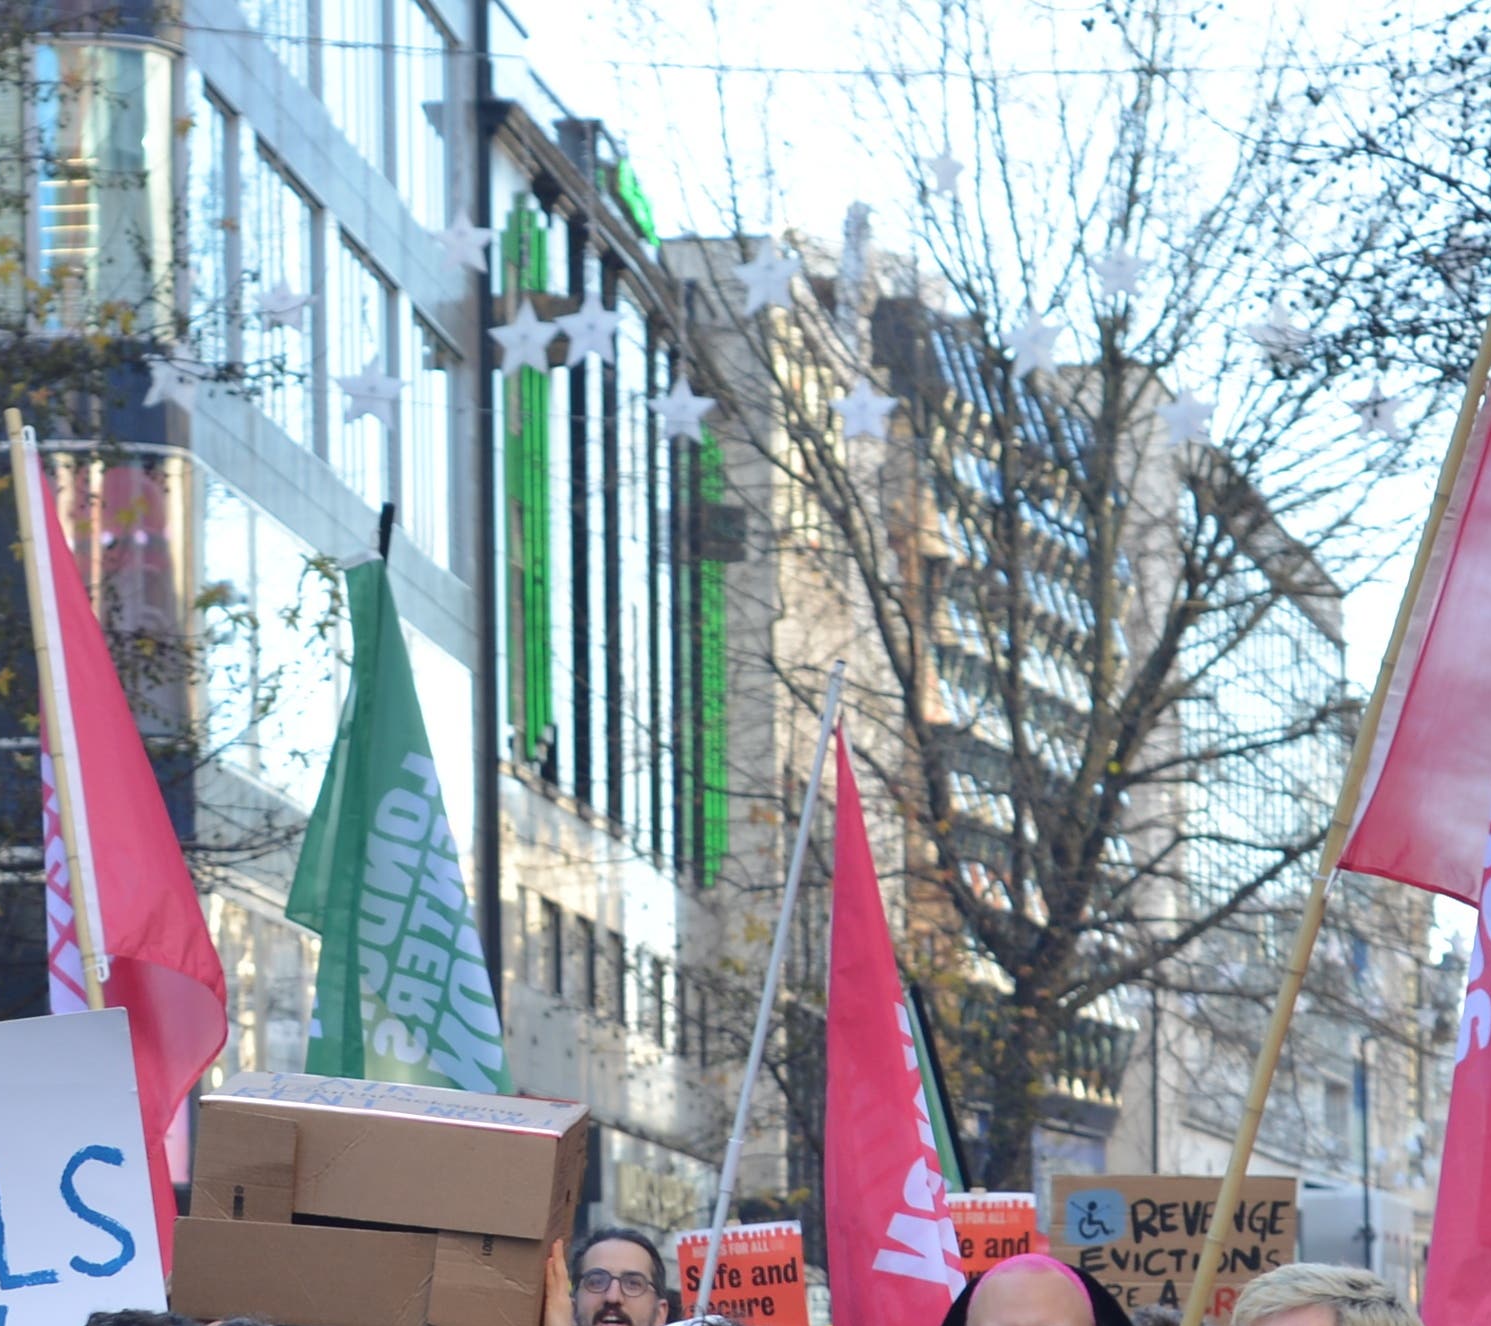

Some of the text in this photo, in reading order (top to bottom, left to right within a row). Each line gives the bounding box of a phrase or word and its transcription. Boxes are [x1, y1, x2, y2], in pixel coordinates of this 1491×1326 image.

[985, 1231, 1029, 1259] and
[686, 1256, 799, 1293] Sfe and
